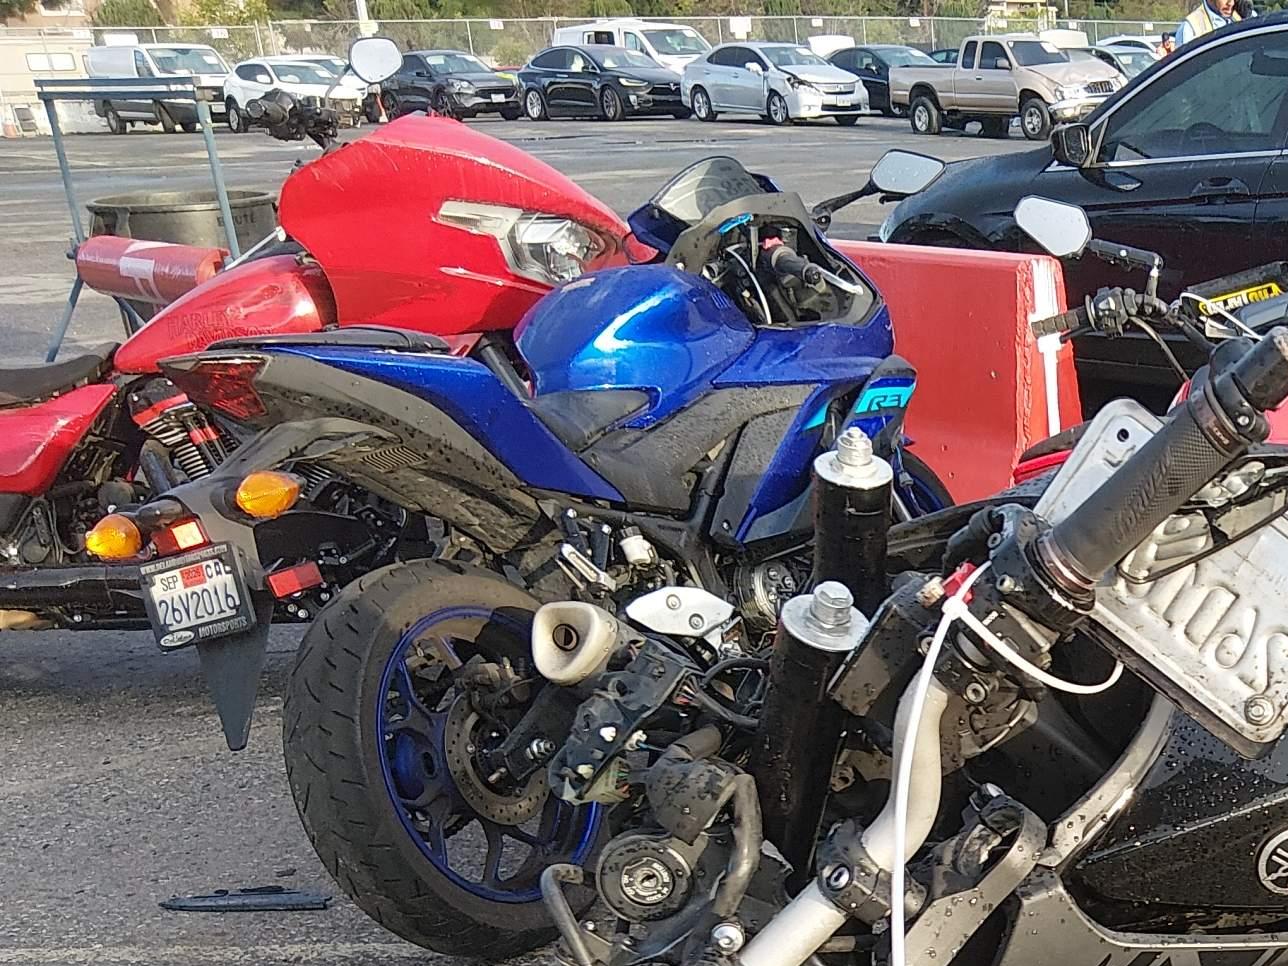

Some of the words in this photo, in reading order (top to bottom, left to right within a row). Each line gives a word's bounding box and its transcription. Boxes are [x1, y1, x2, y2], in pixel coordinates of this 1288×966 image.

[160, 575, 178, 592] SEP
[158, 583, 239, 627] 26V2016
[198, 615, 248, 638] MOTORSPORTS
